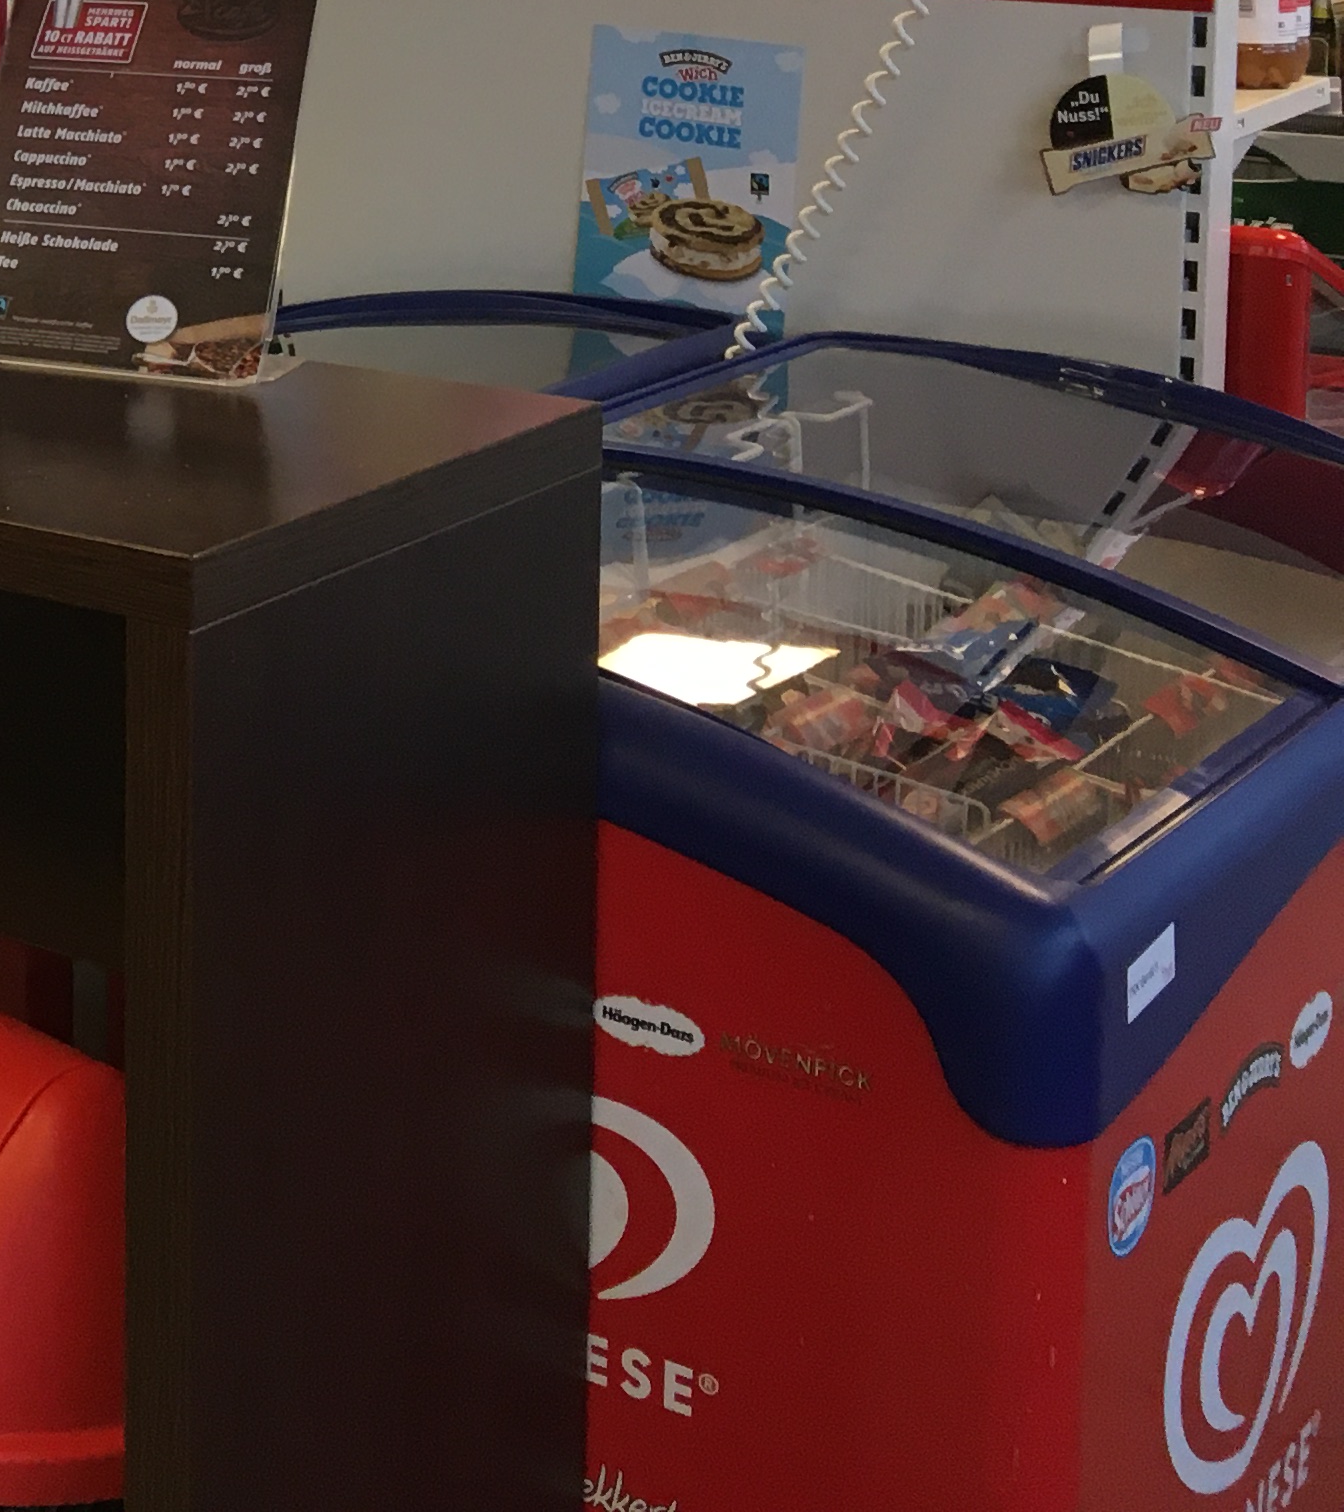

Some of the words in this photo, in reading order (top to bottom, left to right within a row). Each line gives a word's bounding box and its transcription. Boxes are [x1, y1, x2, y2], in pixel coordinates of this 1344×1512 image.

[84, 16, 132, 29] SPART!
[44, 30, 60, 43] 10
[61, 34, 72, 44] CT
[75, 31, 131, 47] RABATT
[173, 58, 222, 72] normal
[238, 61, 272, 75] groß
[678, 67, 718, 82] Wich
[642, 76, 745, 108] COOKIE
[17, 125, 51, 140] Latte
[638, 116, 741, 149] COOKIE
[1072, 138, 1143, 171] SNICKERS
[0, 230, 39, 247] Heiße
[41, 233, 118, 252] Schokolade
[601, 1003, 695, 1045] Häagen-Dazs
[722, 1034, 873, 1093] MÖVENPICK
